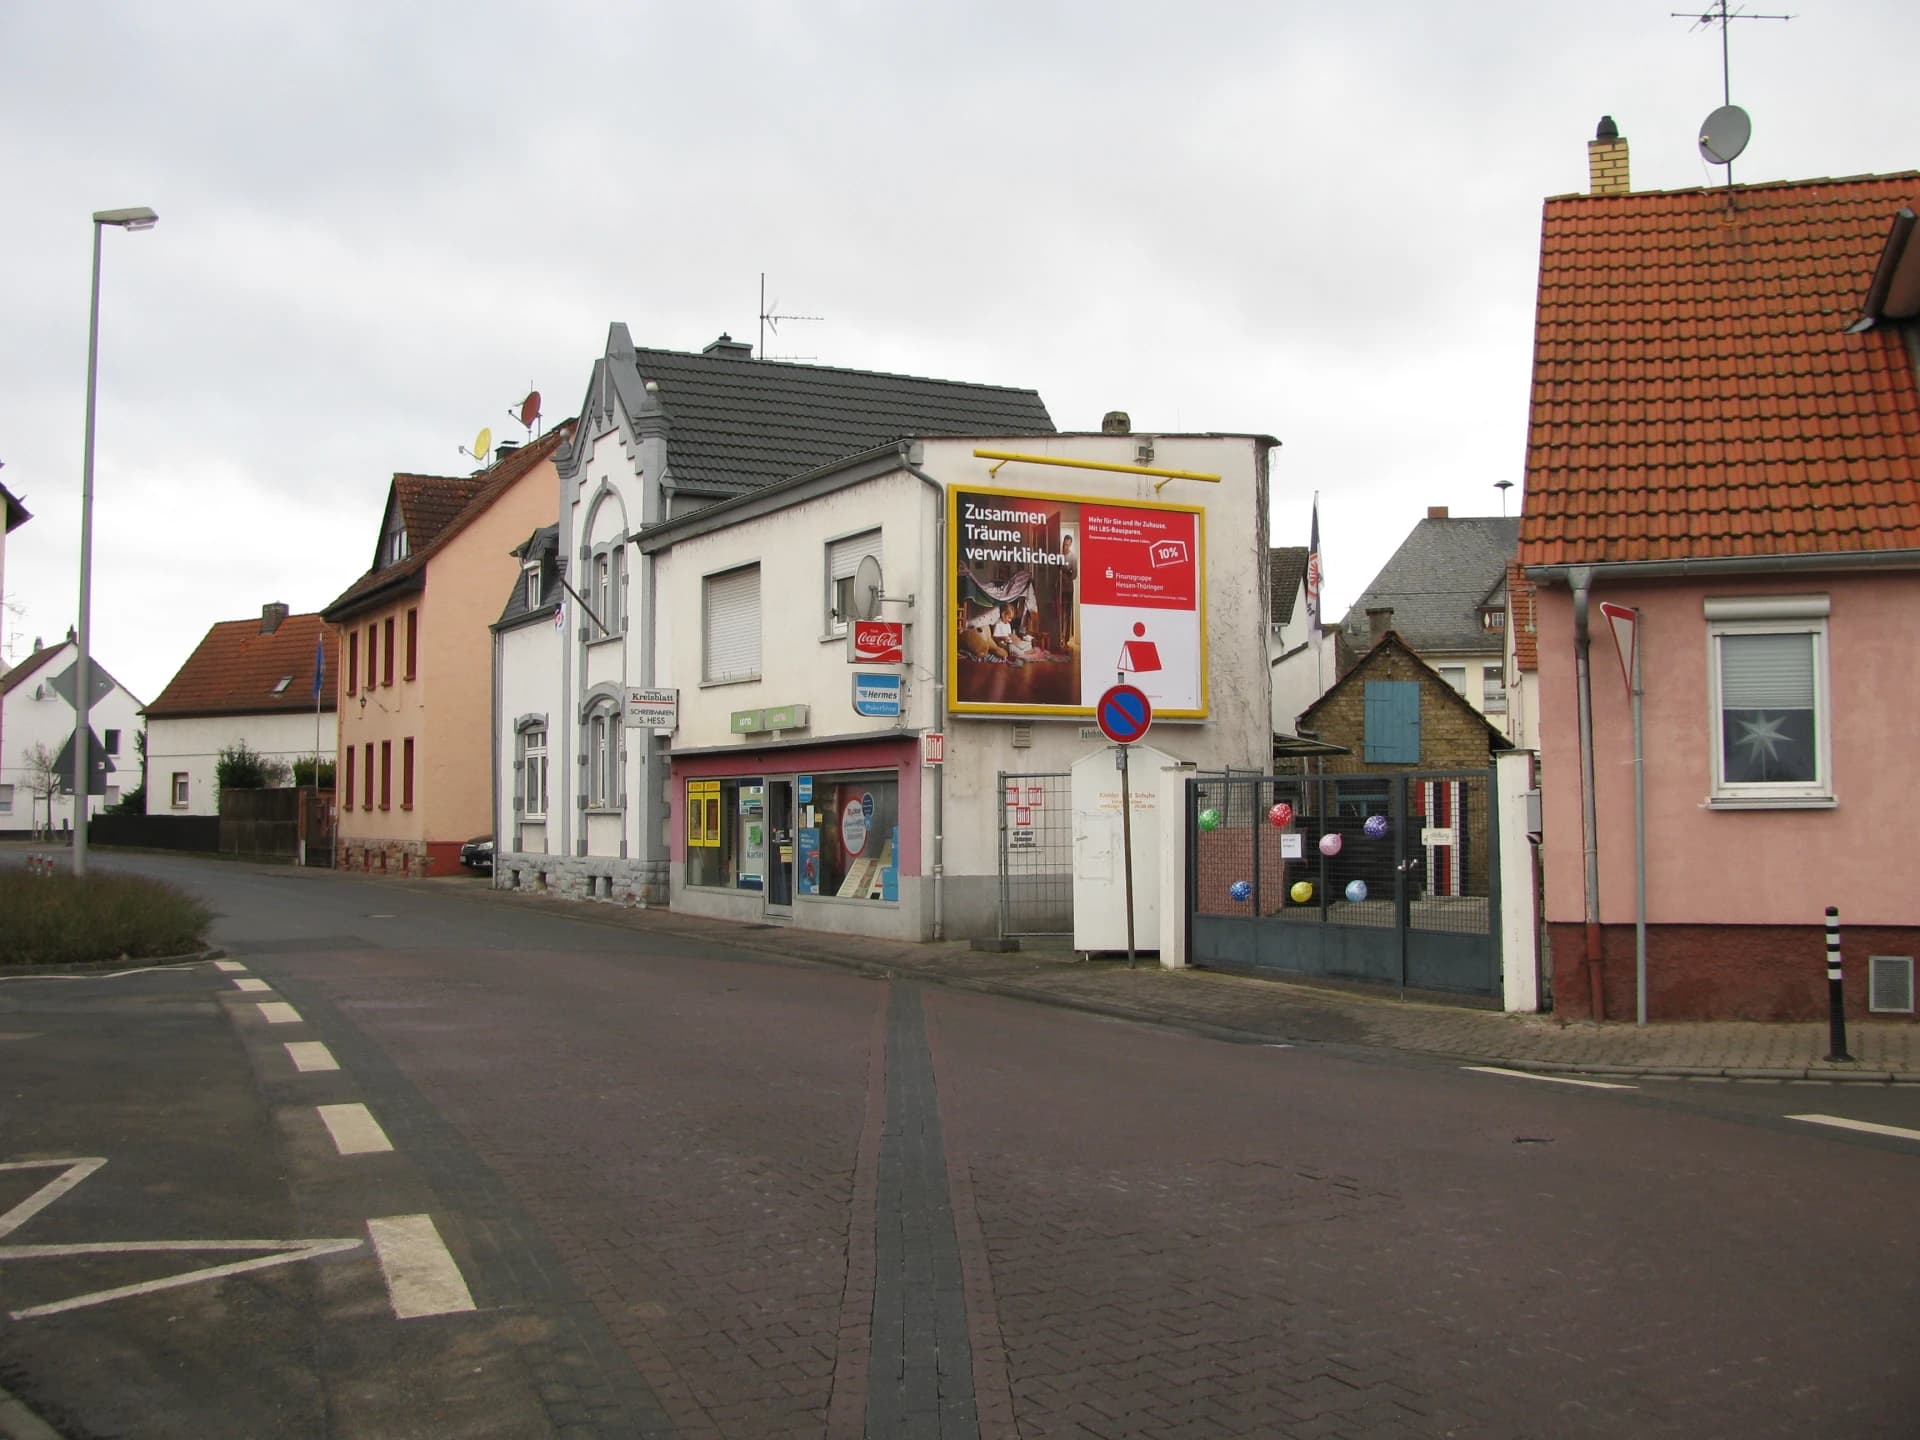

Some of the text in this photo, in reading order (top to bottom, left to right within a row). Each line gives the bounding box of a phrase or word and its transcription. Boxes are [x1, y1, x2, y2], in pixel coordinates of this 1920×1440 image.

[965, 503, 1047, 525] Zusammen
[1088, 516, 1103, 524] Mehr
[1104, 517, 1112, 525] für
[1134, 519, 1142, 527] Ihr
[1142, 520, 1167, 529] Zuhause.
[1088, 524, 1098, 532] Mit
[965, 523, 1021, 543] Träume
[965, 546, 1069, 566] verwirklichen.
[1158, 546, 1178, 560] 10%
[1115, 572, 1152, 583] Finanzgruppe
[1115, 581, 1164, 592] Hessen-Thüringen
[857, 631, 898, 648] Coca-Cola
[867, 690, 898, 700] Hermes
[647, 716, 666, 725] HESS
